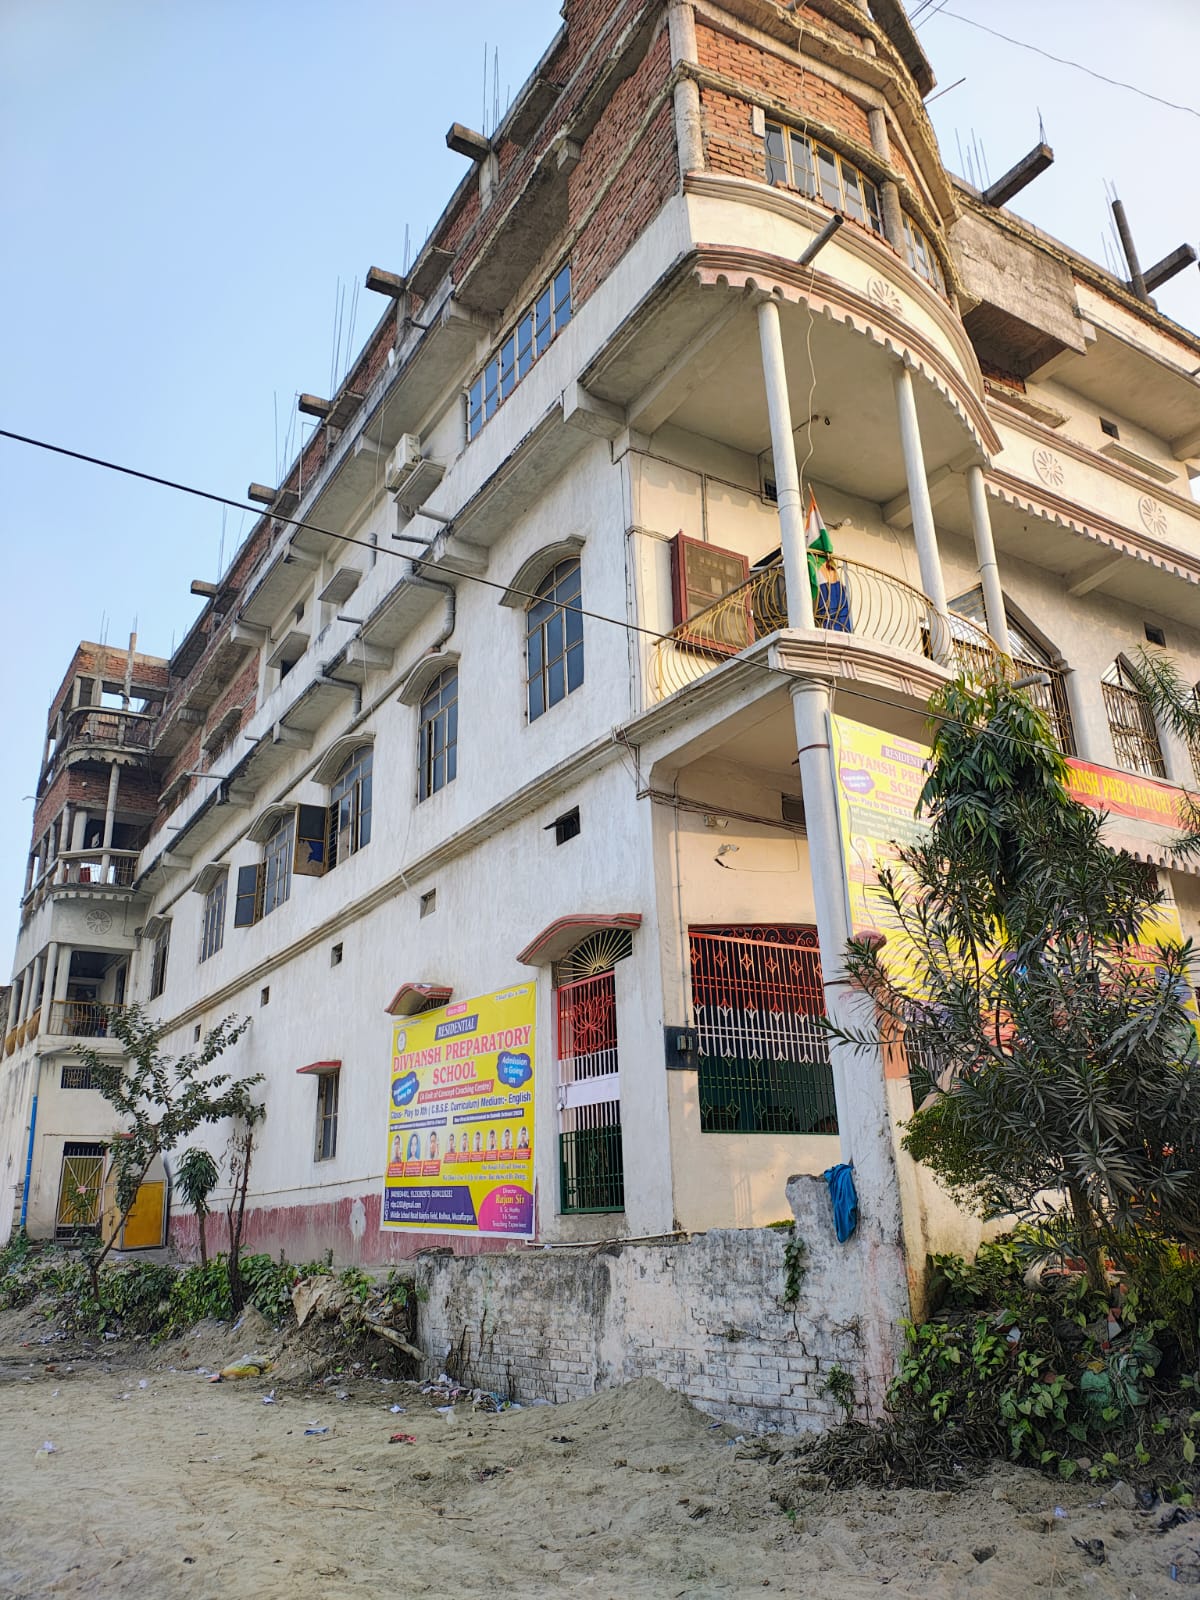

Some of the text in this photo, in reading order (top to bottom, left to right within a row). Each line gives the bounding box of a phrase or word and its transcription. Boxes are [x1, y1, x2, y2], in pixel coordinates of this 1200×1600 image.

[890, 780, 921, 800] SCHO
[1101, 775, 1173, 815] PREPARATORY
[438, 1018, 475, 1038] RESIDENTIAL
[393, 1026, 532, 1073] DIVYANSH PREPARATORY
[502, 1057, 527, 1066] Admission
[509, 1066, 523, 1076] Going
[432, 1061, 477, 1085] SCHOOL
[404, 1108, 413, 1118] Play
[414, 1107, 420, 1116] to
[509, 1092, 531, 1106] English
[496, 1194, 525, 1206] Rajan Sir
[401, 1211, 410, 1219] School
